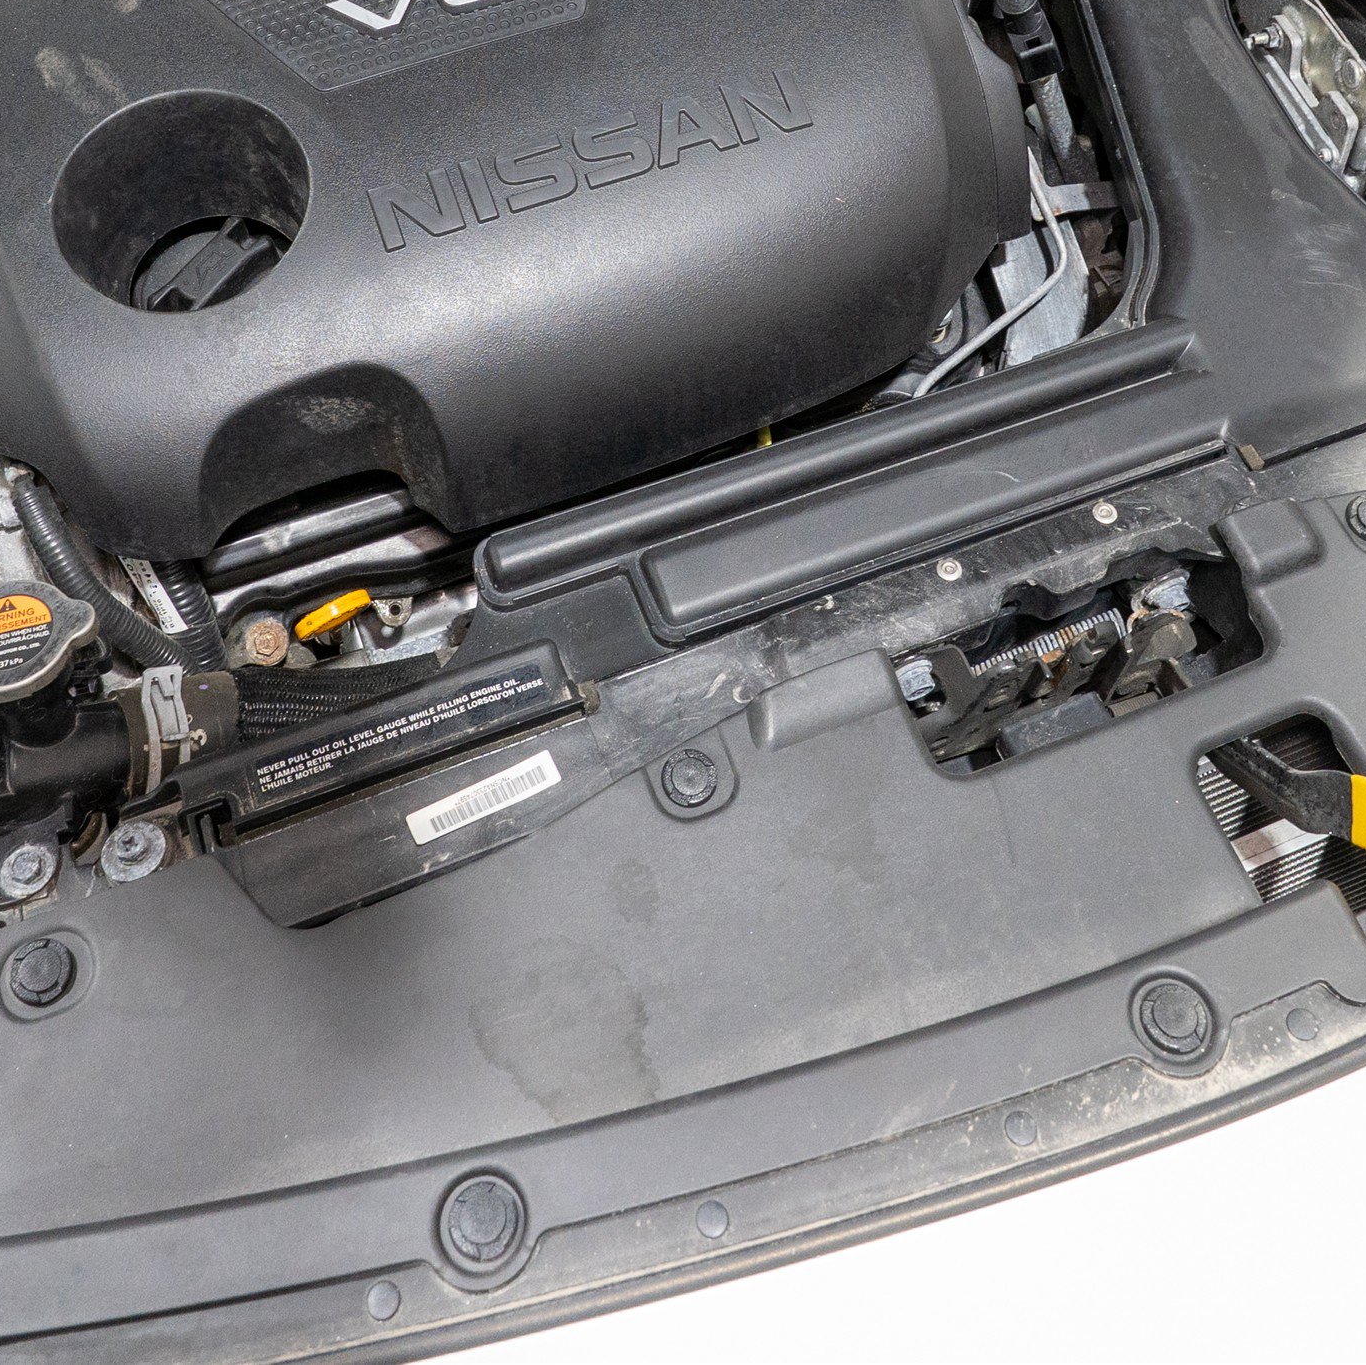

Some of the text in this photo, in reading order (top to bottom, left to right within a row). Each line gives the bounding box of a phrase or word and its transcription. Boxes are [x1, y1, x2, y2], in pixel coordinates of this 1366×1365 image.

[366, 69, 814, 254] NISSAN
[8, 656, 24, 666] kPa
[10, 627, 32, 637] WHEN
[255, 676, 520, 776] NEVER PULL OUT OIL LEVEL GAUGE WHILE FILLING ENGINE OIL.
[258, 677, 544, 785] NE JAMAIS RETIRER LA JAUGE DE NIVEAU D'HUILE LORSQU'ON VERSE
[259, 760, 334, 792] L'HUILE MOTEUR.
